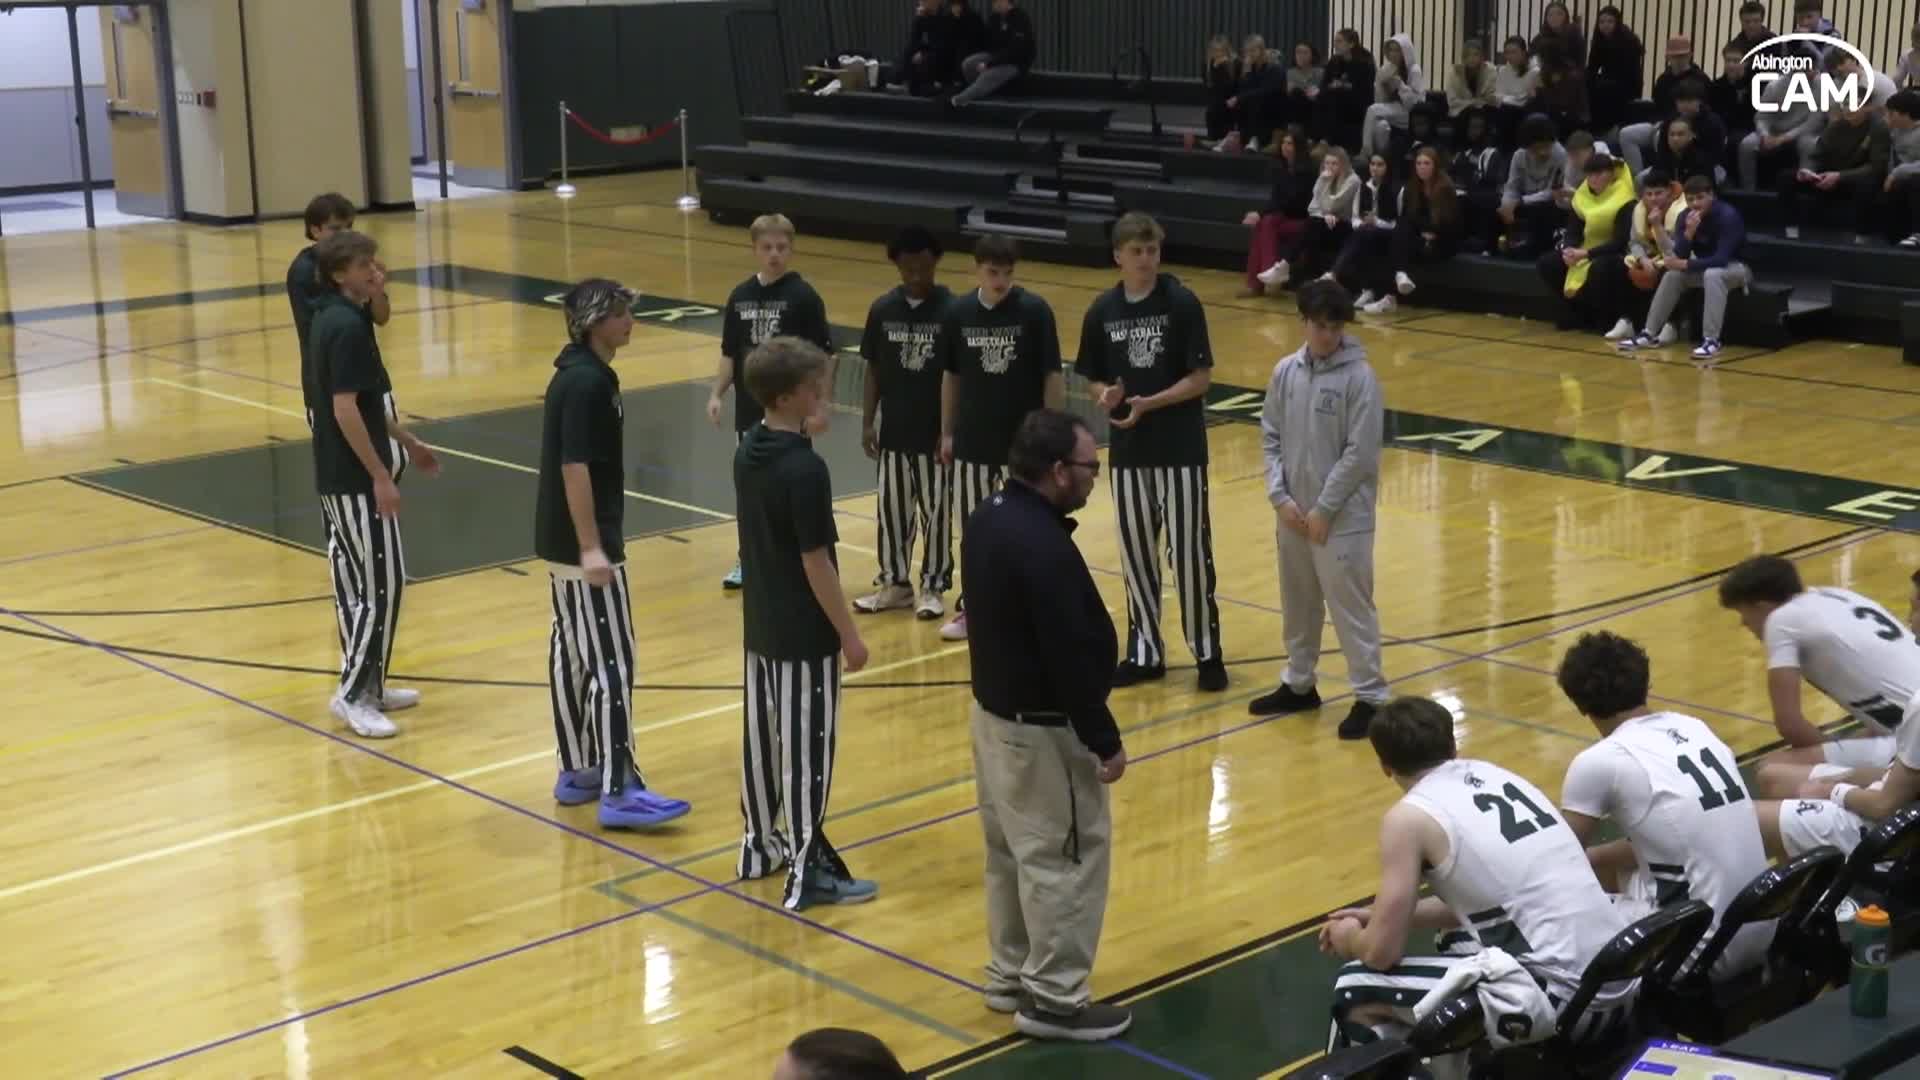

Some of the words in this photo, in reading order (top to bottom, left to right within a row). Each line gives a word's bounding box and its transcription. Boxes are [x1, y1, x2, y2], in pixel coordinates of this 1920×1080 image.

[1852, 606, 1904, 641] 3
[1677, 747, 1745, 812] 11
[1472, 782, 1558, 844] 21
